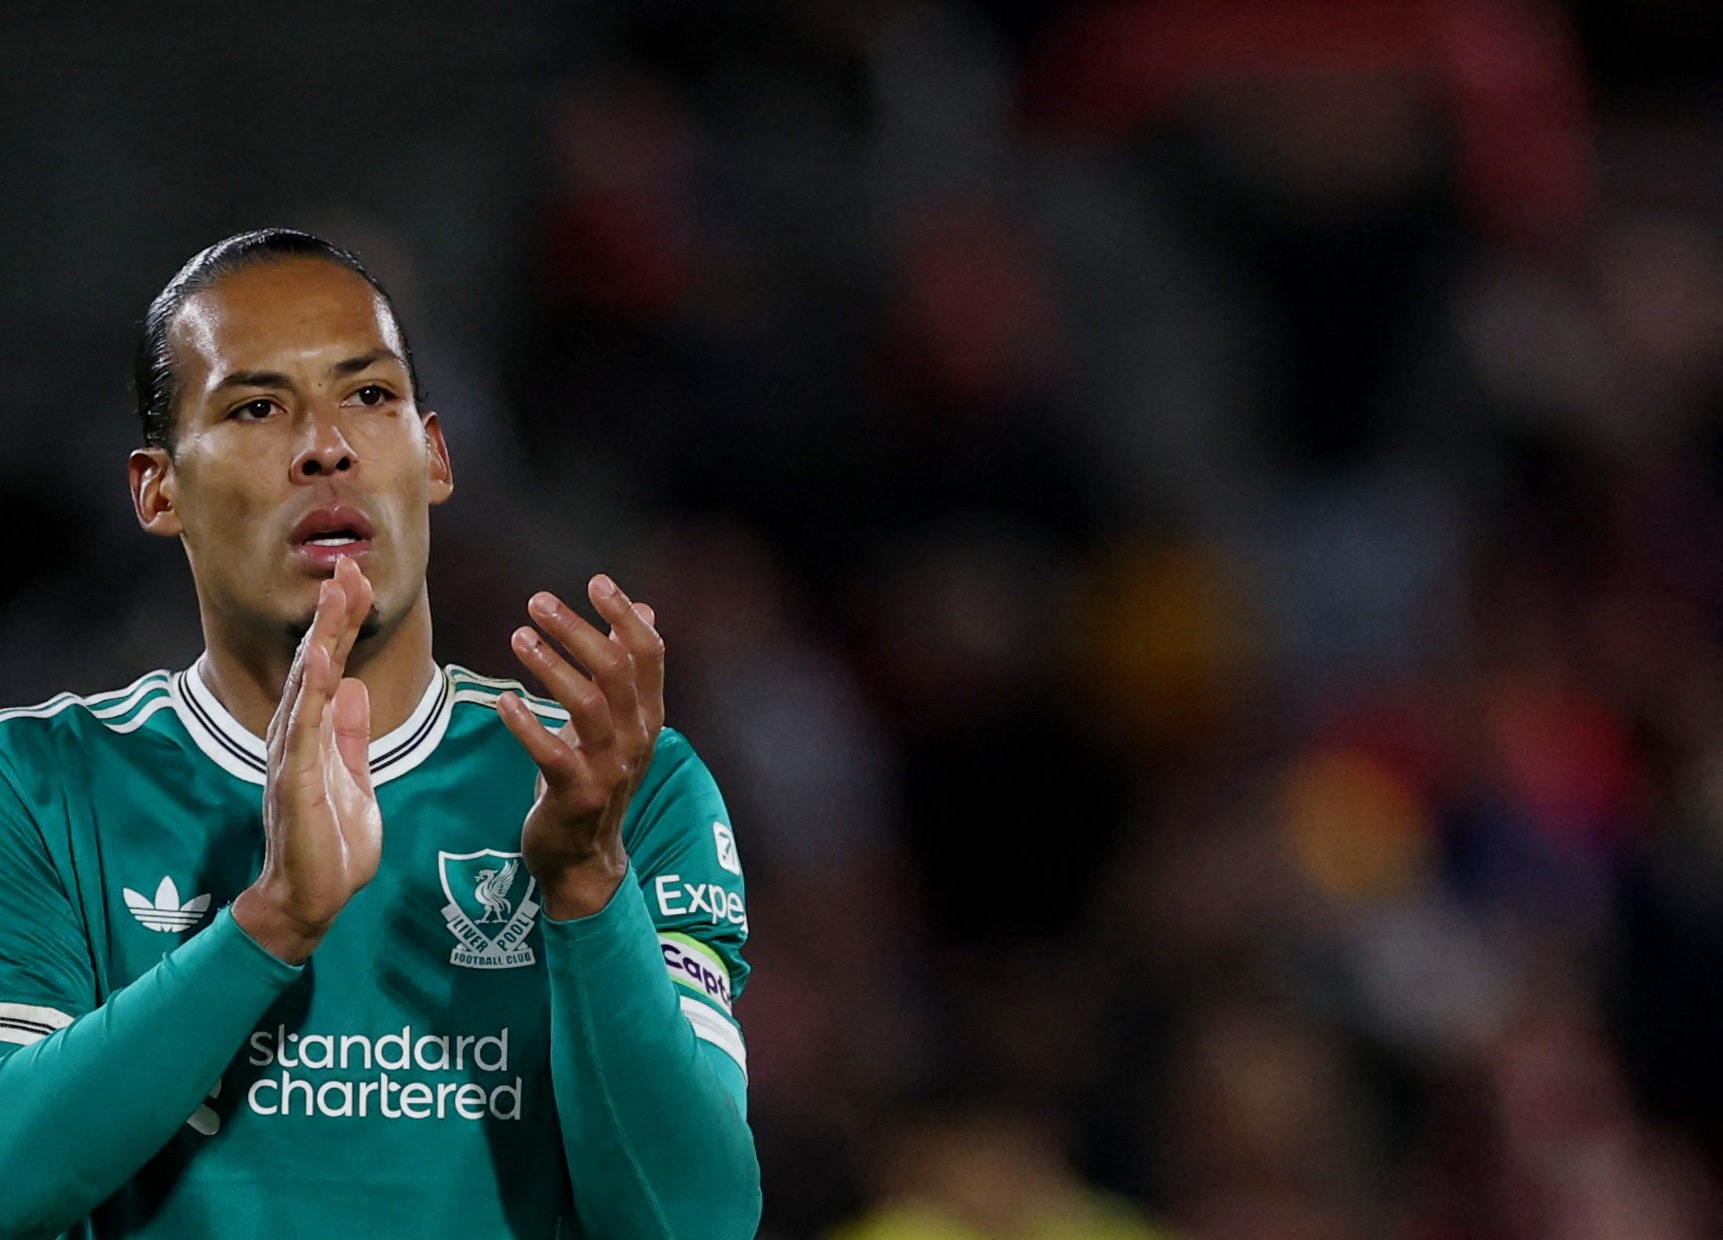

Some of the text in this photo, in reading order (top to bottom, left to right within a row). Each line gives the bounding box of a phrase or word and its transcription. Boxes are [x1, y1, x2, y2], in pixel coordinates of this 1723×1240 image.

[452, 918, 530, 953] LIVER POOL
[454, 952, 531, 966] FOOTBALL CLUB
[661, 943, 732, 1008] Capt
[248, 1024, 509, 1072] standard
[247, 1070, 523, 1121] chartered
